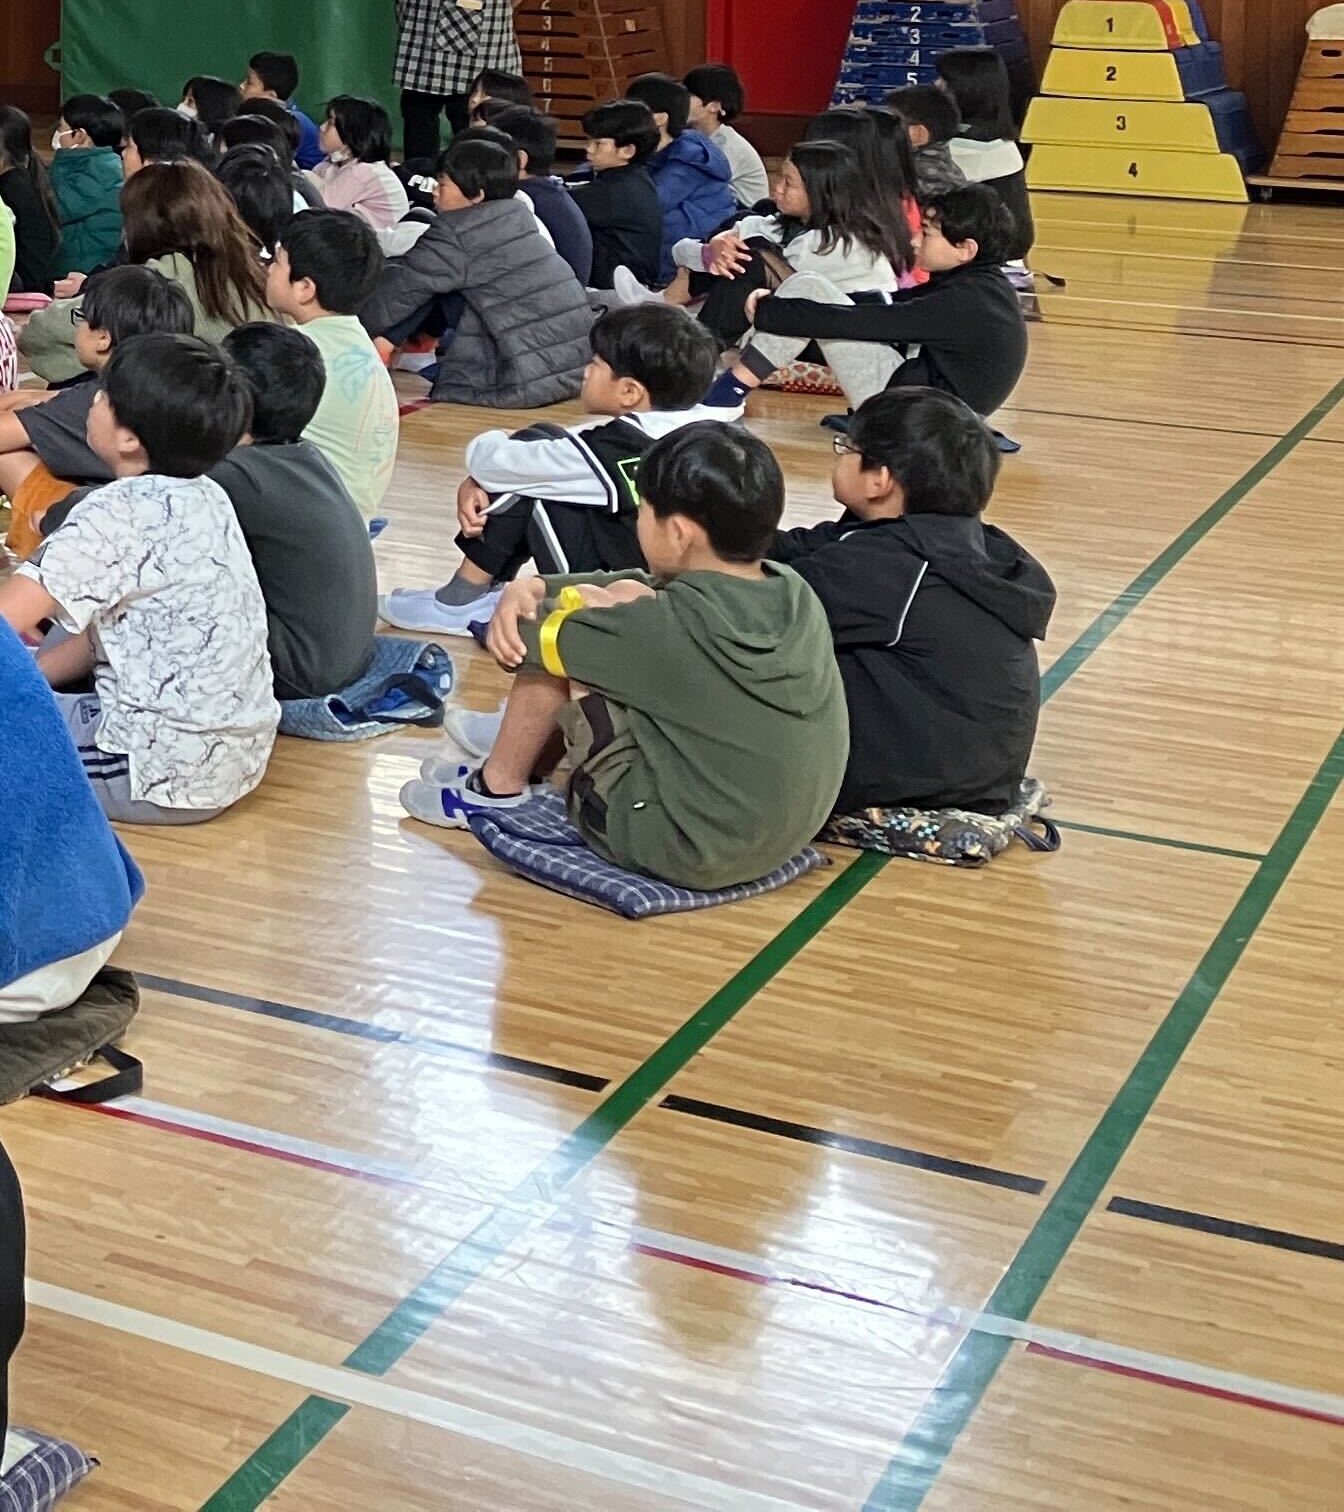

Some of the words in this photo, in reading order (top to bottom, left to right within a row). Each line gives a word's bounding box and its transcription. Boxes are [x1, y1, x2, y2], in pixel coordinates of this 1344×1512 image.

[910, 6, 921, 23] 2
[542, 16, 552, 31] 3
[1106, 17, 1114, 33] 1
[910, 28, 921, 45] 3
[908, 49, 920, 66] 4
[1106, 66, 1117, 81] 2
[1116, 115, 1127, 131] 3
[1128, 162, 1138, 178] 4
